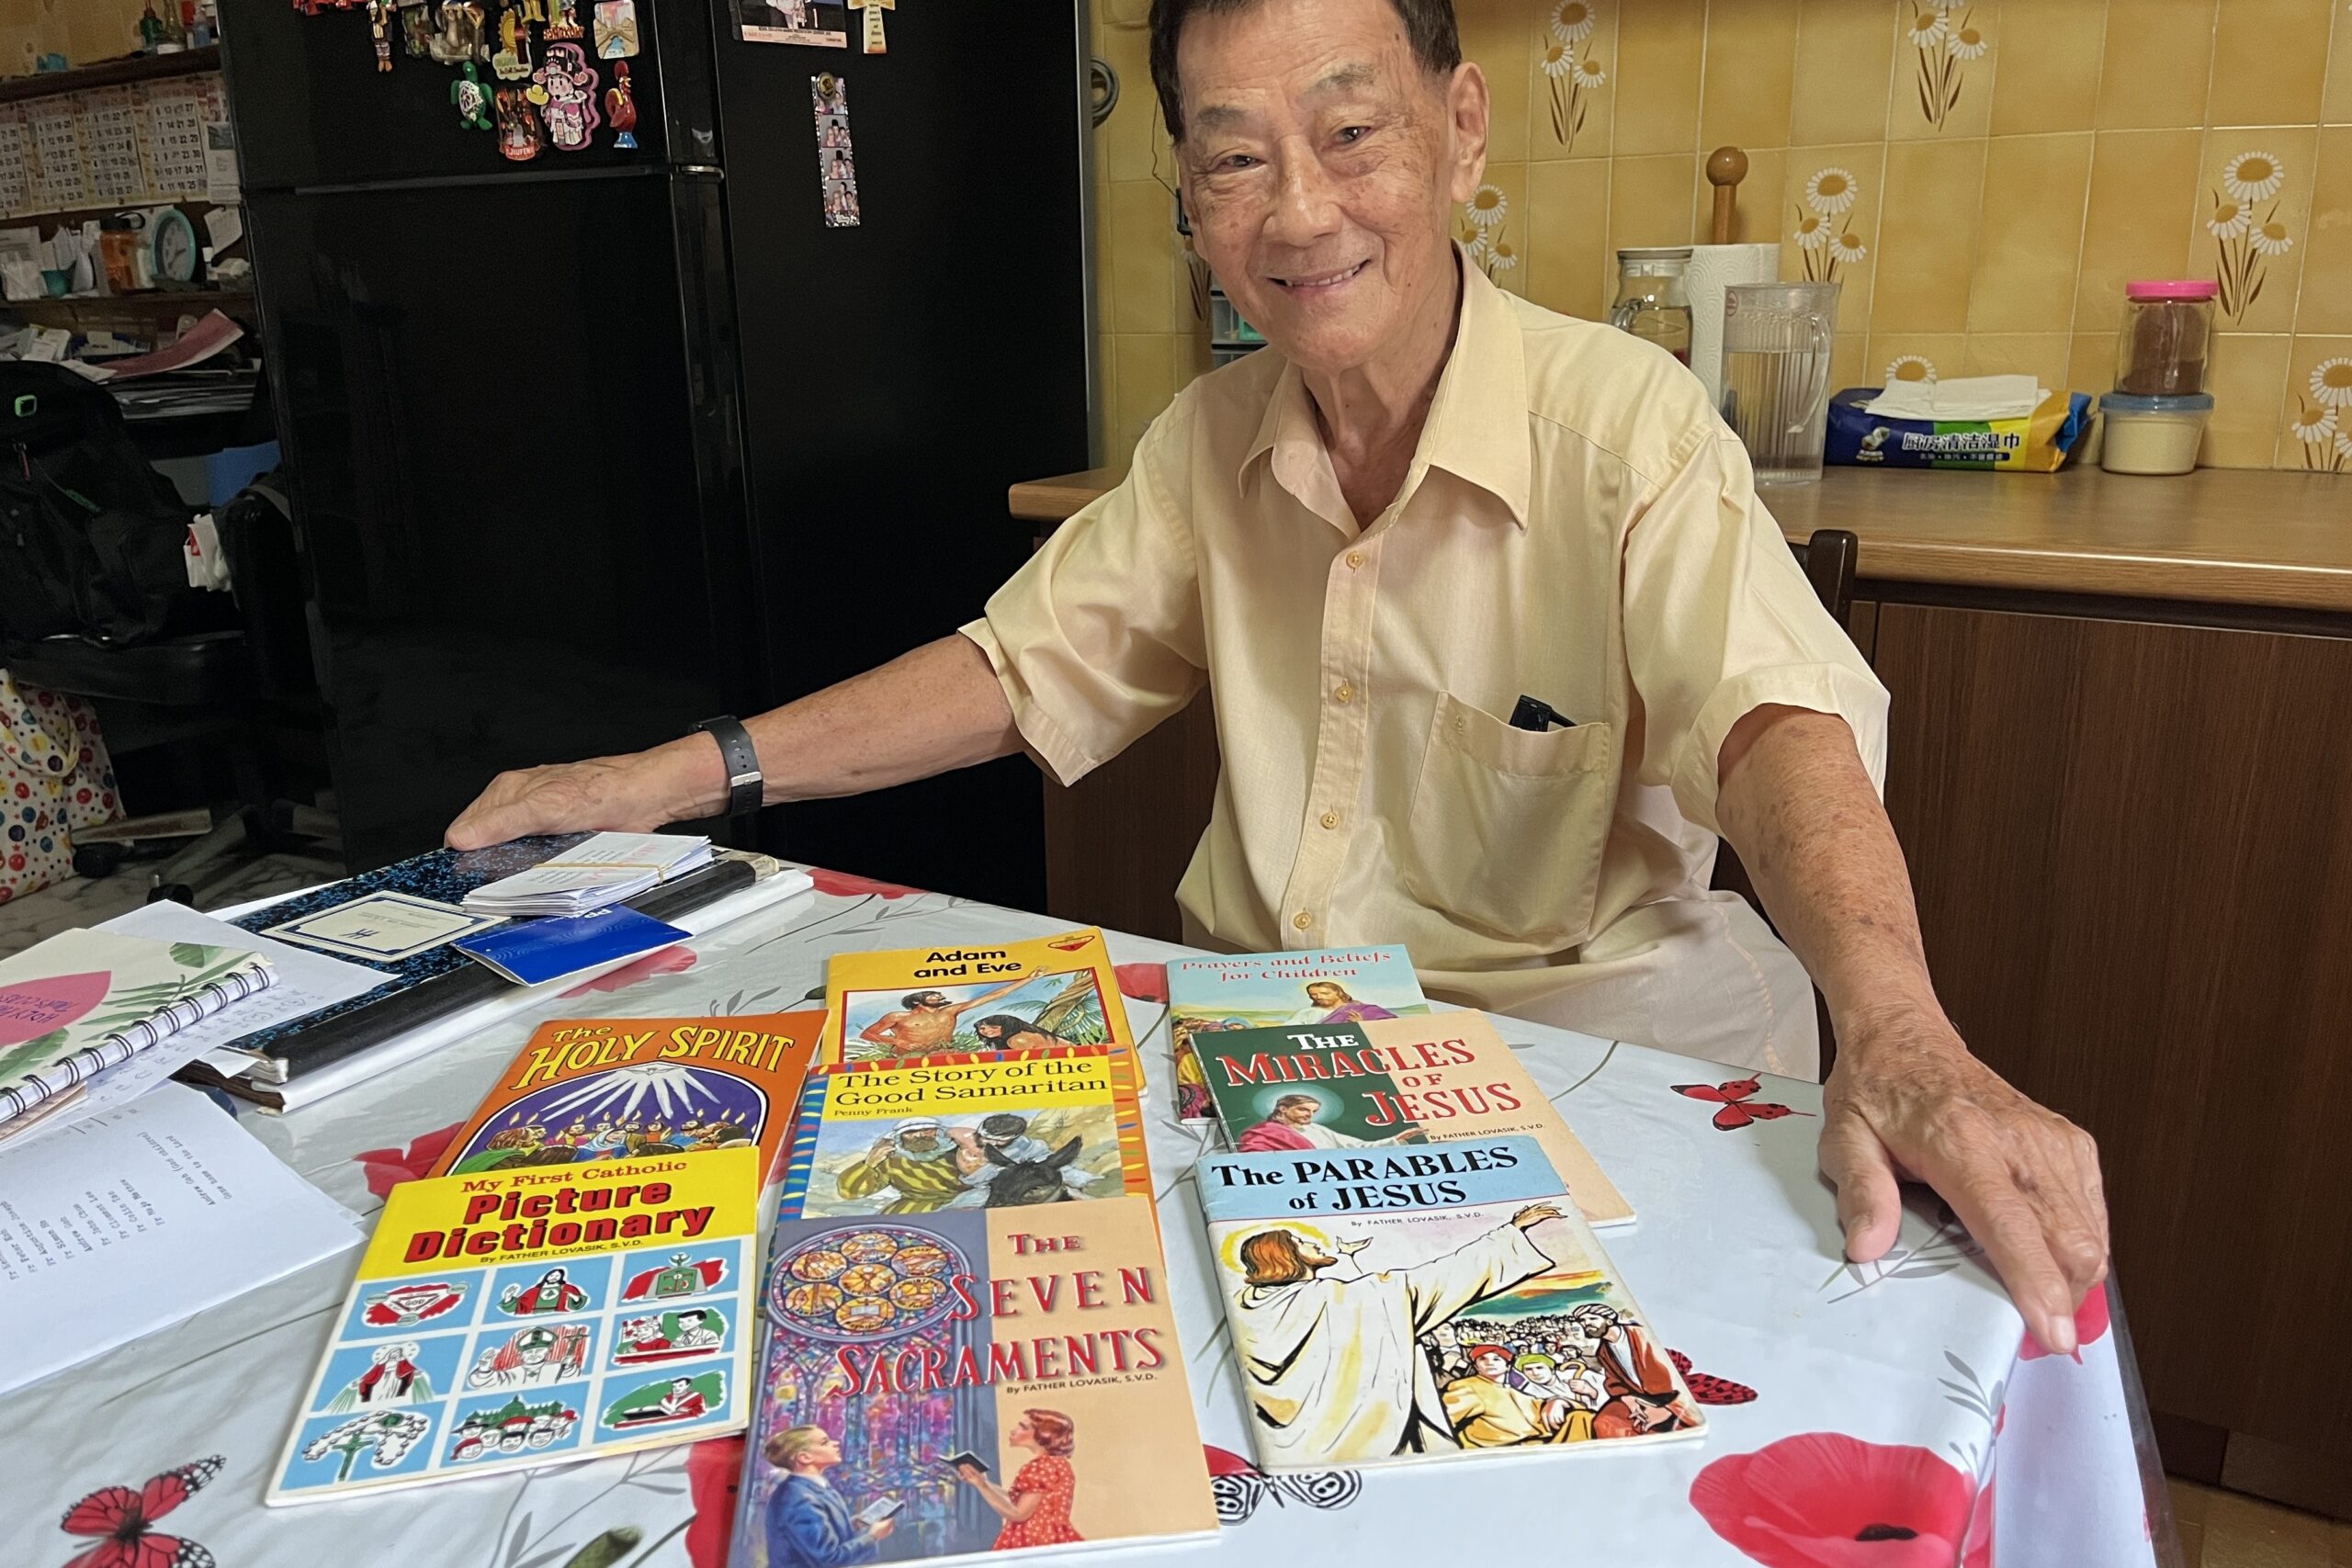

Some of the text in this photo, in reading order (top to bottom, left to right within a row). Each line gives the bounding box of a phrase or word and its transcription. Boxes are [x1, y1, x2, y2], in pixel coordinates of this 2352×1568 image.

[1901, 432, 2020, 452] 厨房清洁湿巾
[926, 950, 1007, 963] Adam
[1182, 950, 1392, 971] Prayers and Beliefs
[913, 960, 1023, 978] and Eve
[1217, 966, 1358, 984] for Children
[551, 1026, 612, 1043] The
[508, 1026, 796, 1090] HOLY SPIRIT
[1216, 1038, 1476, 1088] MIRACLES
[837, 1060, 1092, 1089] The Story of the
[1402, 1074, 1444, 1088] OF
[835, 1077, 1109, 1106] Good Samaritan
[834, 1106, 913, 1118] Penny Frank
[1362, 1082, 1522, 1127] JESUS
[1430, 1134, 1442, 1142] By
[1443, 1131, 1476, 1139] FATHER
[182, 1150, 193, 1159] the
[1211, 1146, 1518, 1187] The PARABLES
[181, 1173, 195, 1184] Goh
[460, 1161, 687, 1194] My First Catholic
[193, 1186, 216, 1205] Andrew
[463, 1182, 673, 1225] Picture
[1288, 1180, 1467, 1211] of JESUS
[1367, 1218, 1402, 1226] FATHER
[402, 1205, 715, 1264] Dictionary
[481, 1255, 497, 1263] By
[500, 1250, 549, 1260] FATHER
[944, 1266, 1156, 1321] SEVEN
[824, 1327, 1162, 1397] SACRAMENTS
[1007, 1373, 1159, 1394] By FATHER LOVASIK, S.V.D.
